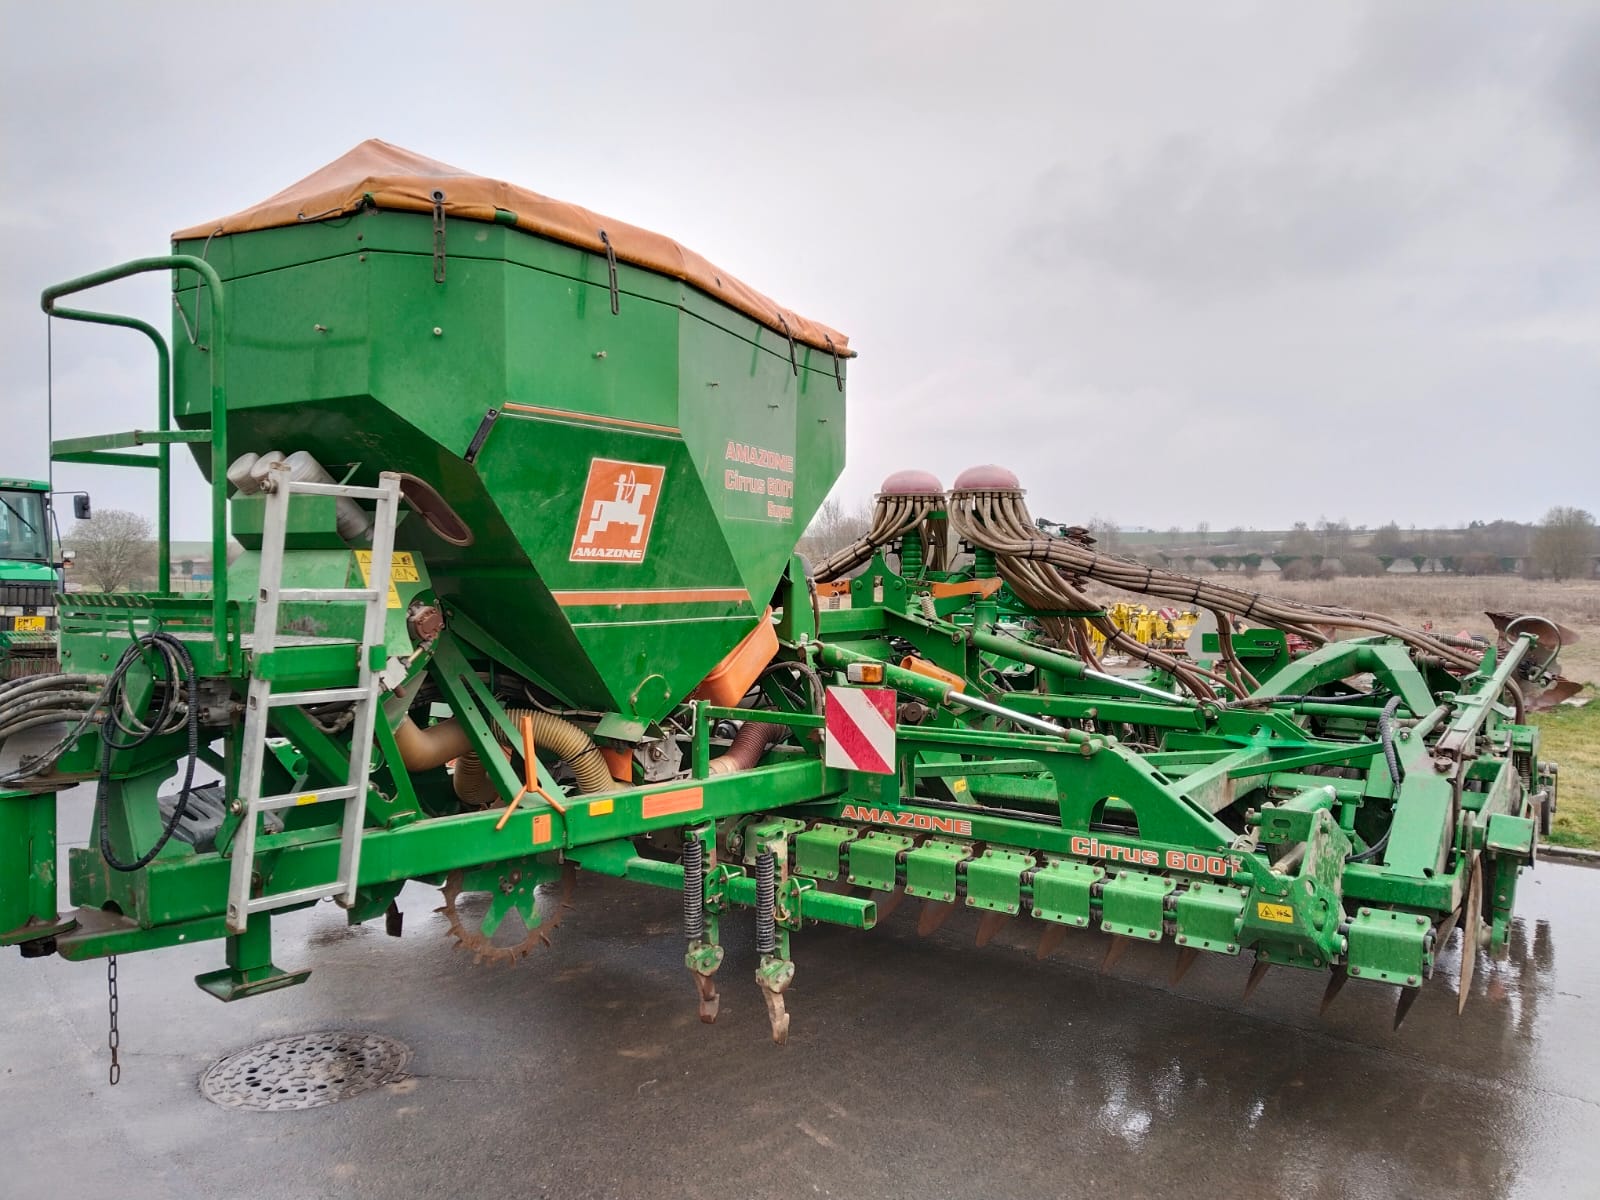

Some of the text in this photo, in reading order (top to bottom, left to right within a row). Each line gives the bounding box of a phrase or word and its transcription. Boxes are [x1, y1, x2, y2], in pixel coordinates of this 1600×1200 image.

[725, 441, 794, 473] AMAZONE
[724, 469, 766, 494] Cirrus
[573, 547, 643, 558] AMAZONE
[840, 804, 972, 836] AMAZONE
[1071, 836, 1159, 866] Cirrus
